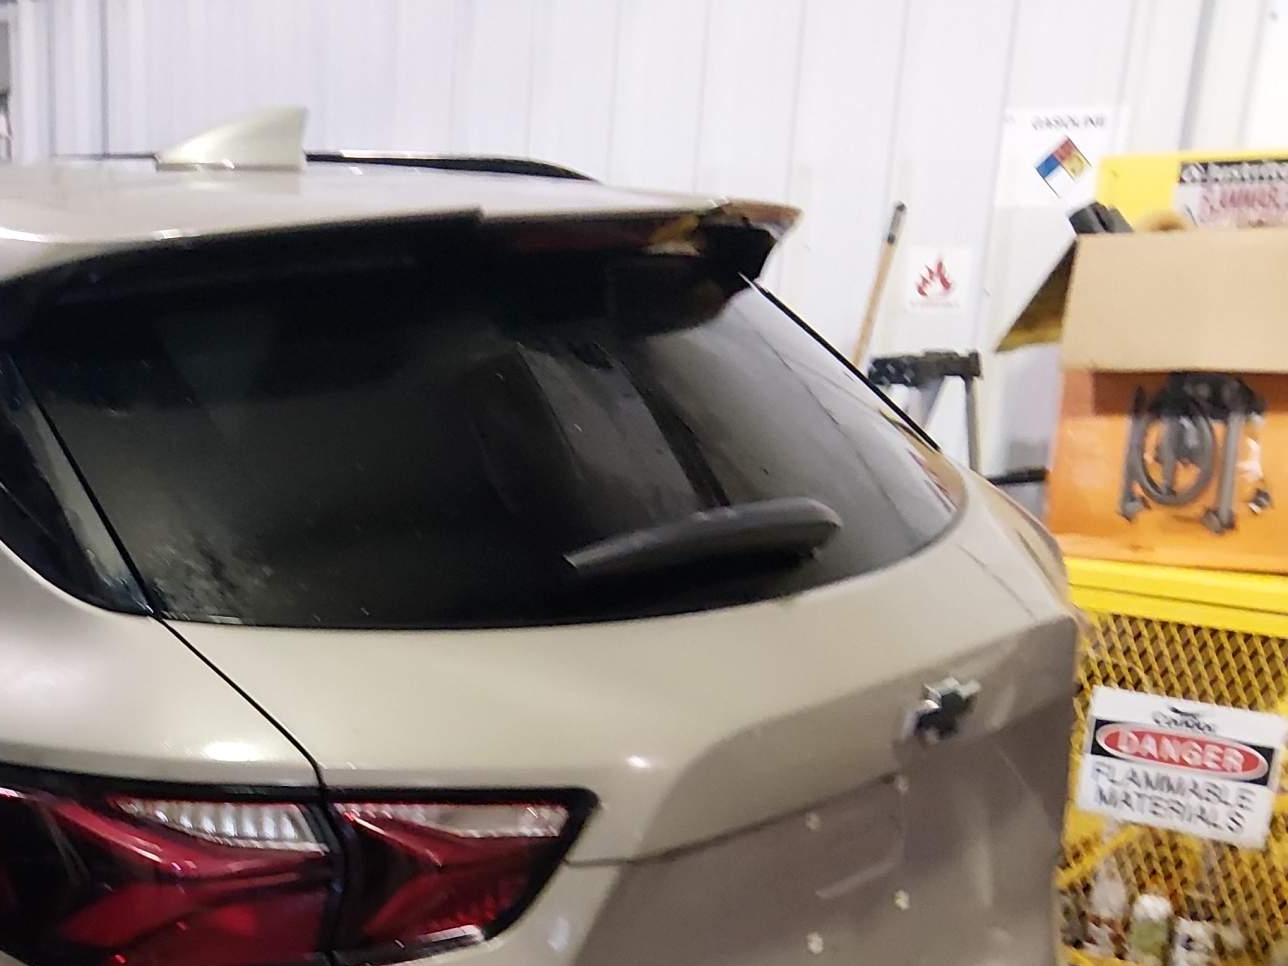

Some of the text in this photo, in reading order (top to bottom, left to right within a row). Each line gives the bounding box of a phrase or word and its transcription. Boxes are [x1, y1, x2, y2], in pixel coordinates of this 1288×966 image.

[1116, 728, 1245, 773] DANGER
[1091, 760, 1256, 813] FLAMMABLE
[1095, 784, 1246, 834] MATERIALS
